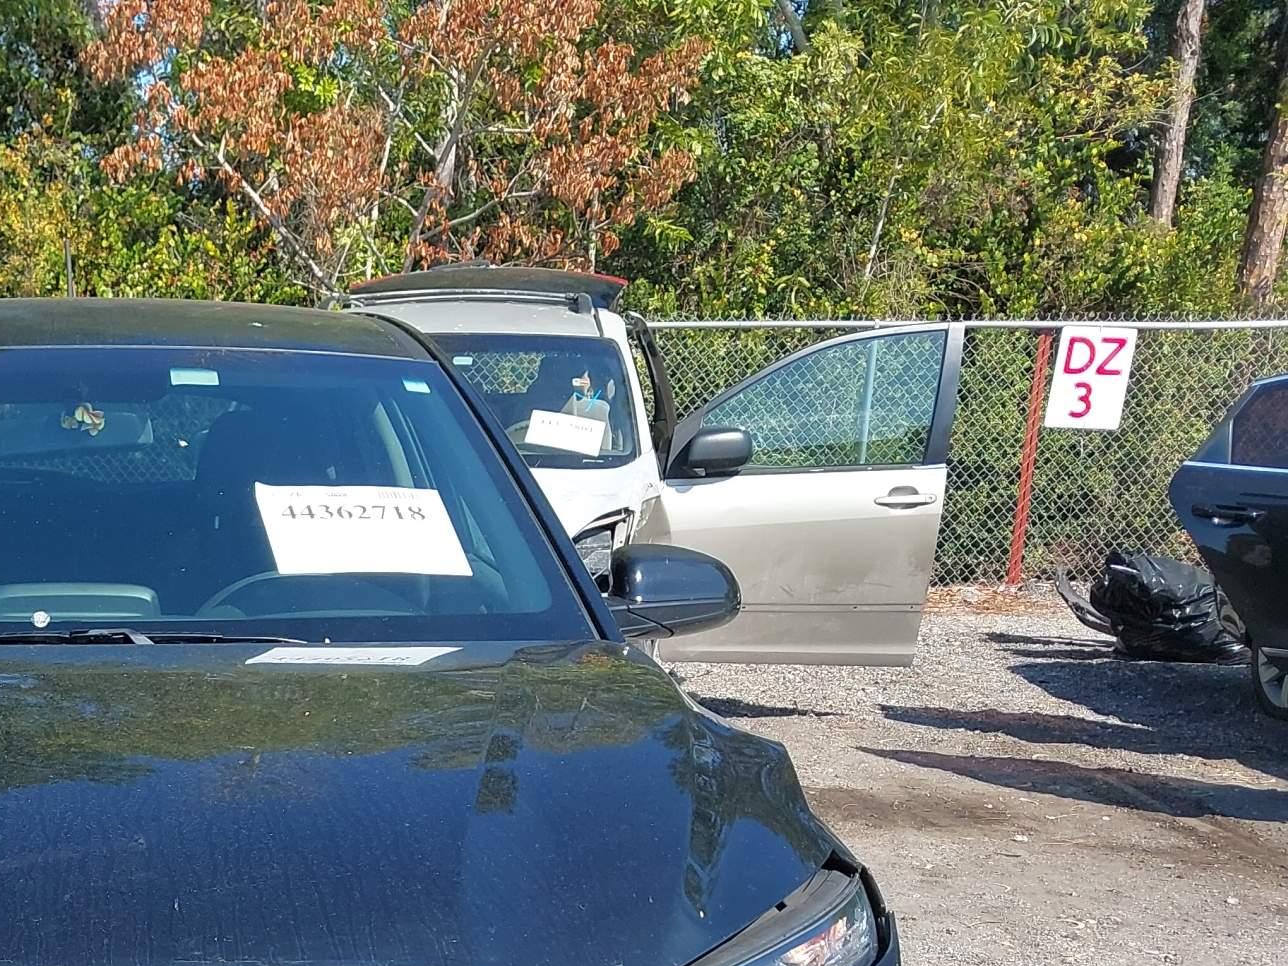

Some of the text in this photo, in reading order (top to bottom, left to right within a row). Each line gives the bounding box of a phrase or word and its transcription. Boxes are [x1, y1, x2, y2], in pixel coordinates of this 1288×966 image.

[1063, 336, 1128, 375] DZ
[1068, 382, 1093, 418] 3
[281, 504, 427, 520] 44362718
